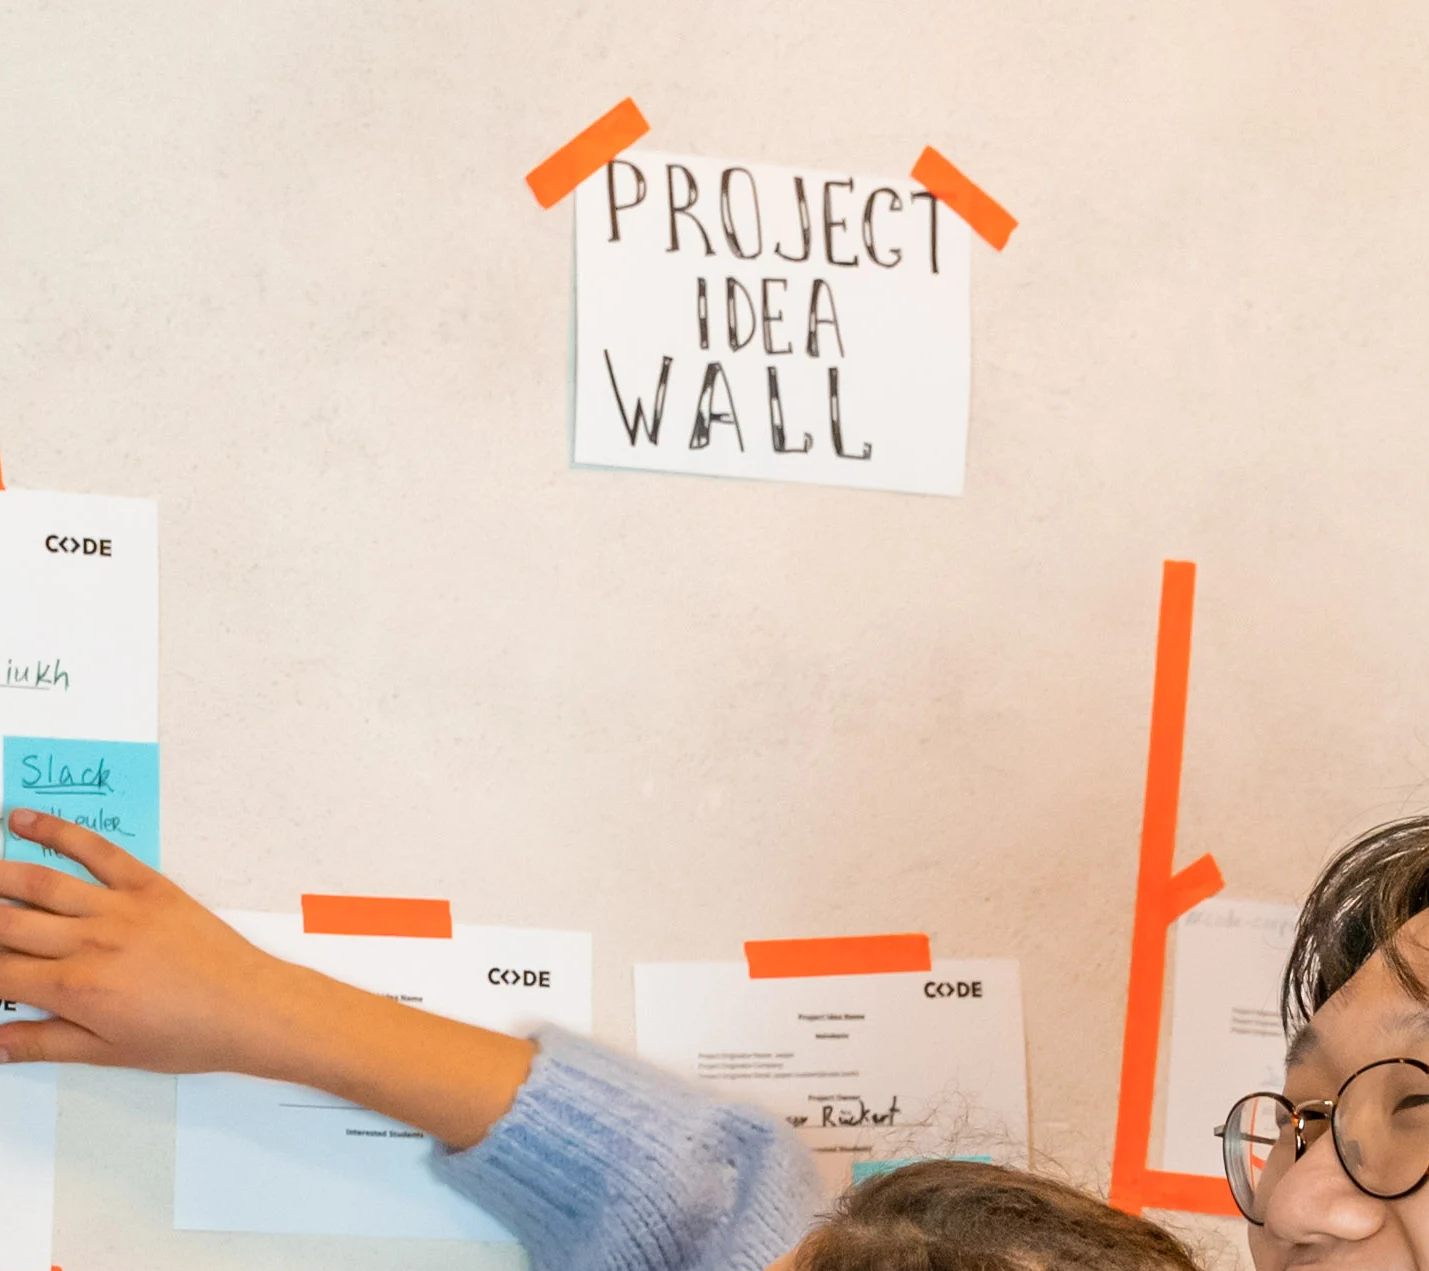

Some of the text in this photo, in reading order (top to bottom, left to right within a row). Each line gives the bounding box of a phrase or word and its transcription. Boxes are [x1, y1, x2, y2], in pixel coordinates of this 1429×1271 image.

[607, 158, 957, 275] PROJECT
[697, 276, 845, 359] IDEA
[604, 348, 872, 461] WALL
[21, 754, 115, 793] Slack
[345, 1128, 425, 1140] Interested Students
